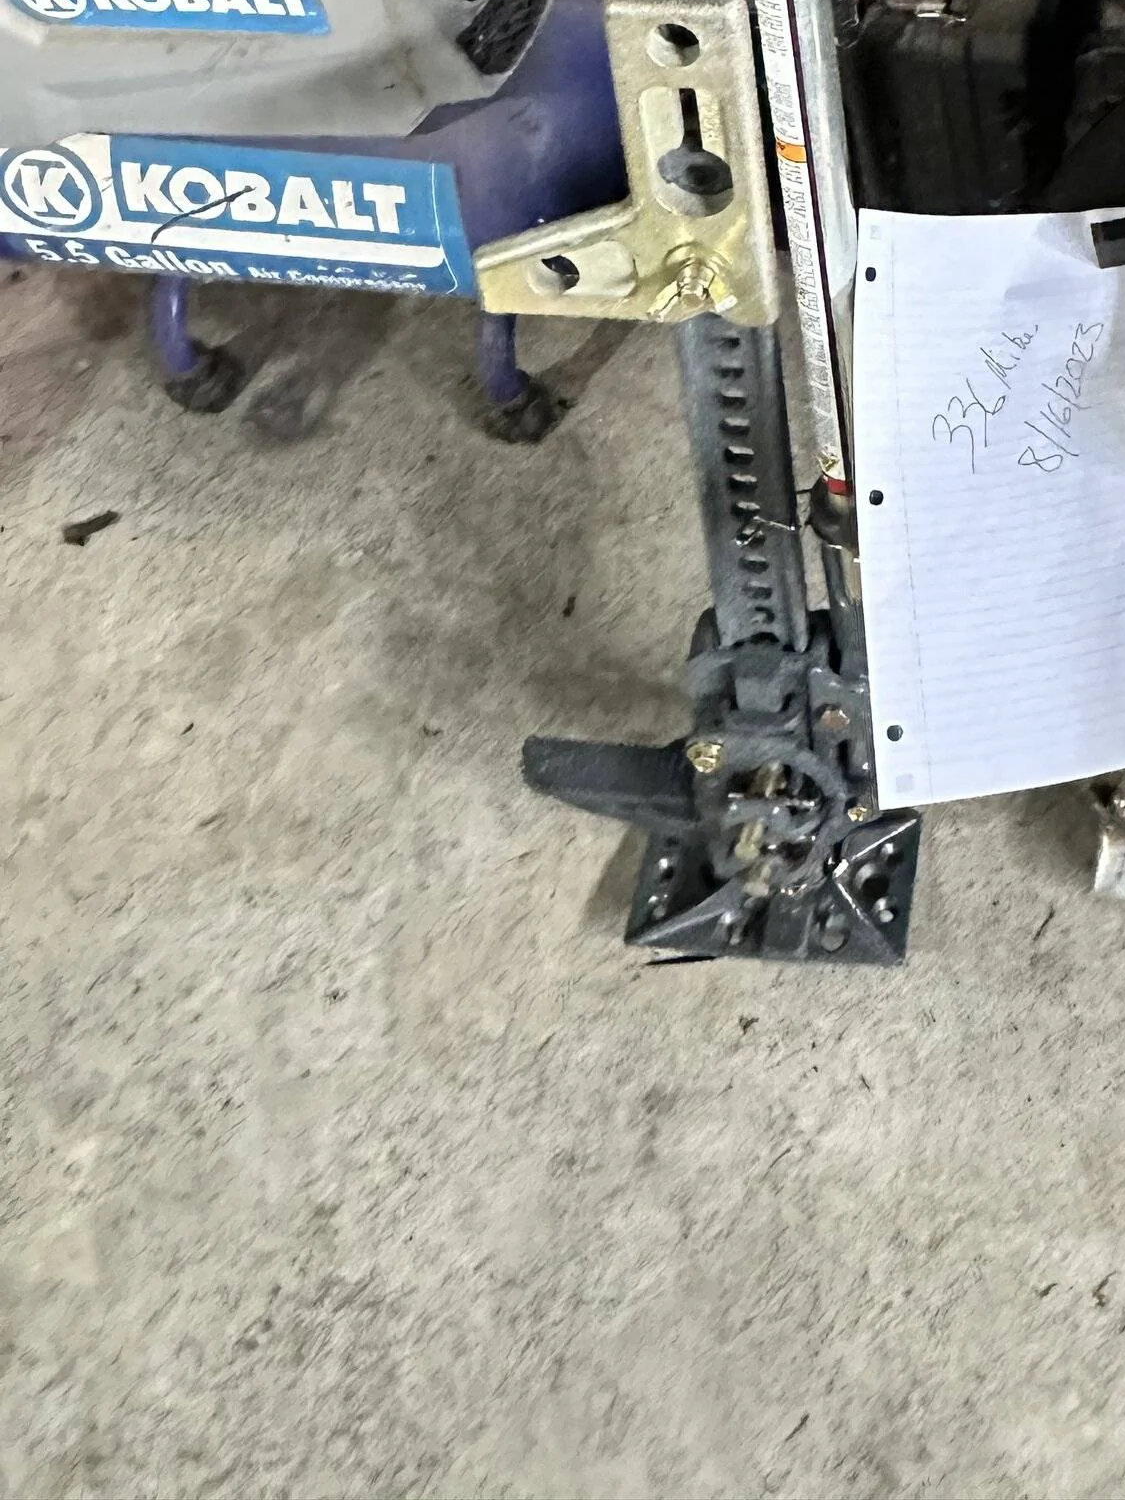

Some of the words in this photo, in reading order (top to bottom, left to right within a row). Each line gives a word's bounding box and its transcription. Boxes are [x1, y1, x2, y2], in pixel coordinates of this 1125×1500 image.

[120, 160, 407, 234] KOBALT
[25, 238, 101, 265] 5.5
[104, 245, 240, 276] Gallon
[931, 377, 1007, 475] 336
[1017, 322, 1104, 473] 8/16/2023
